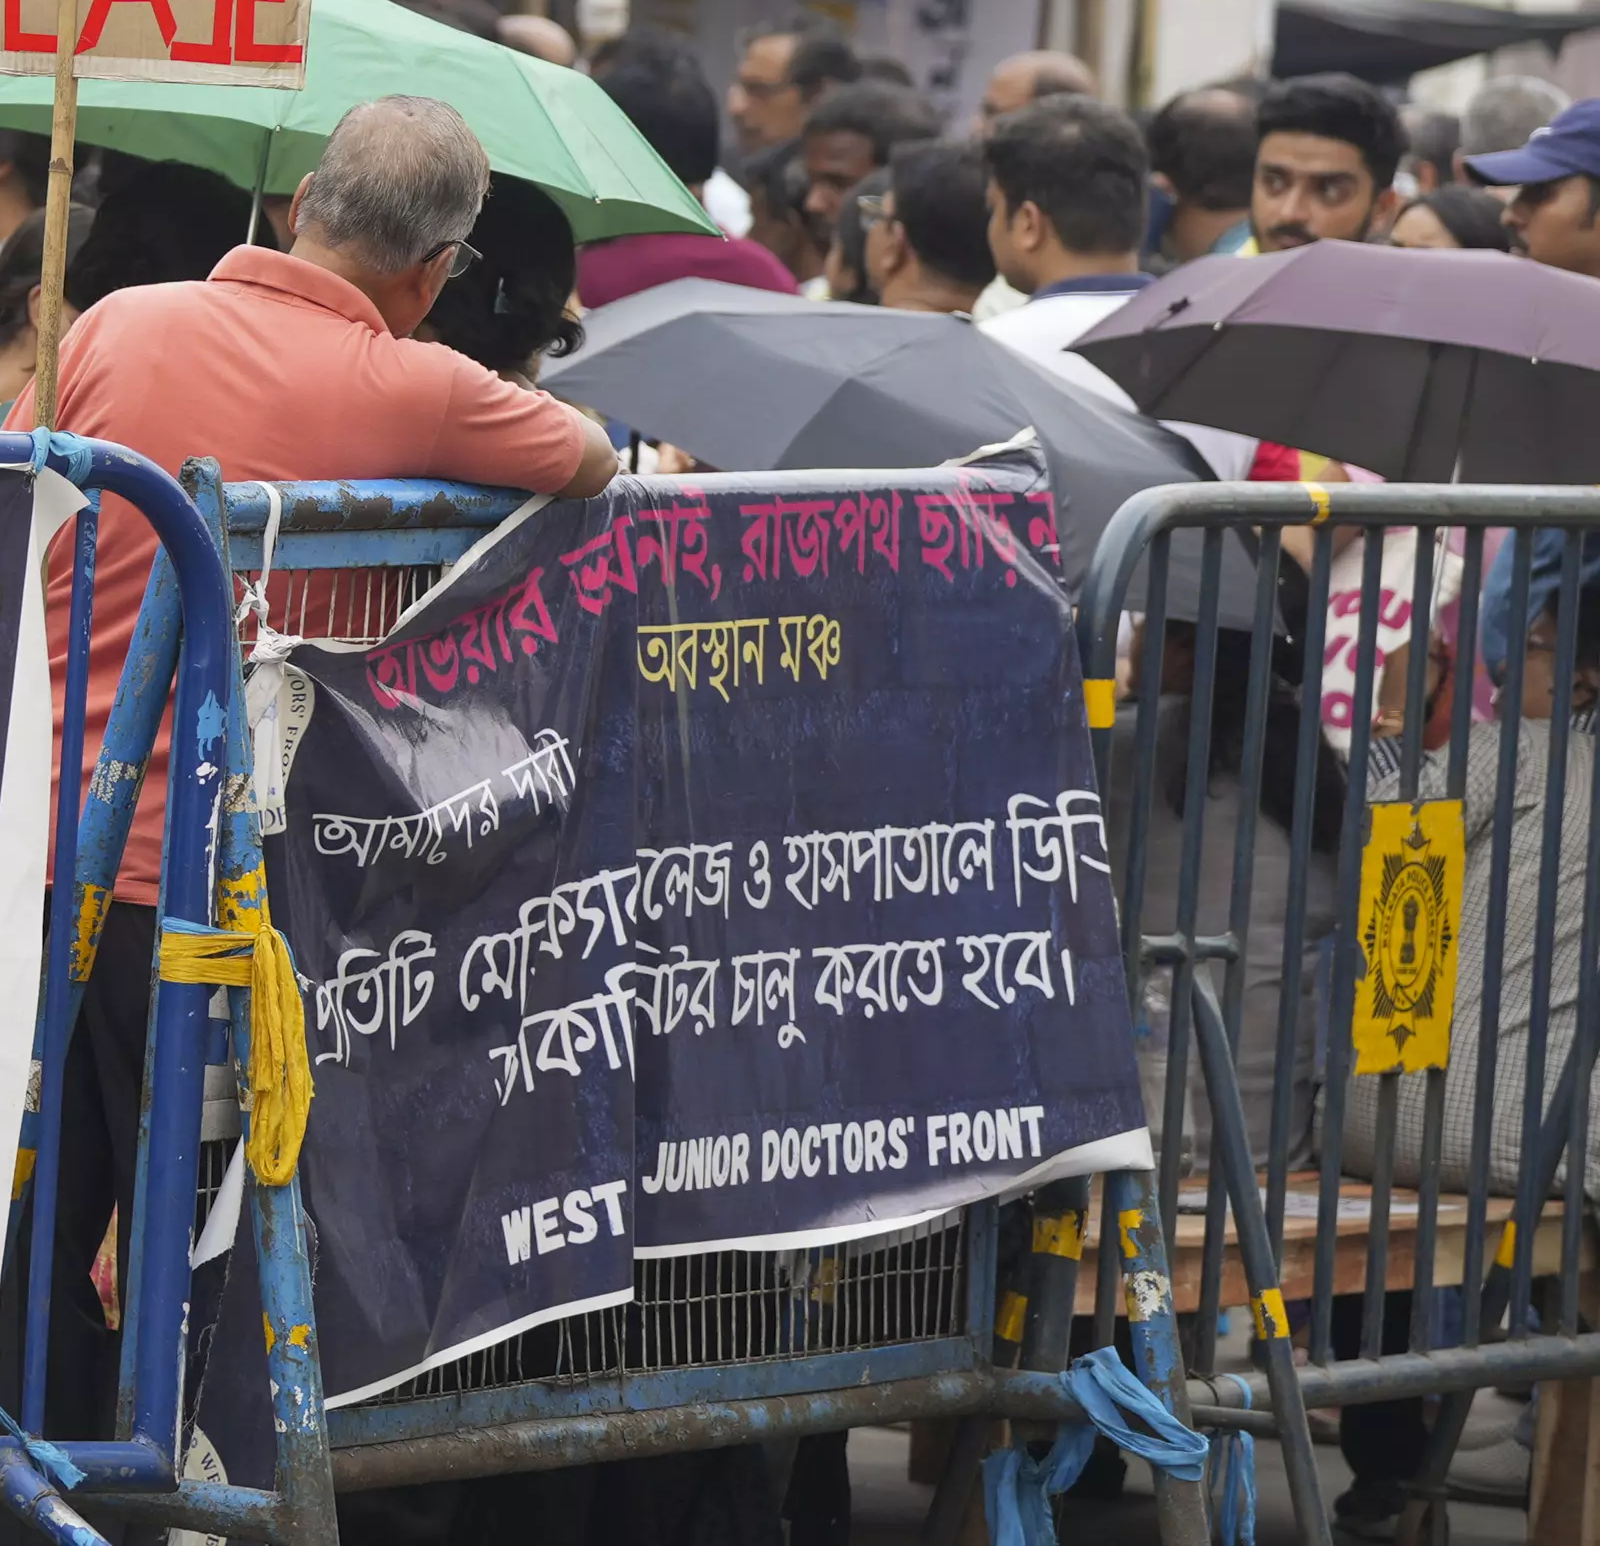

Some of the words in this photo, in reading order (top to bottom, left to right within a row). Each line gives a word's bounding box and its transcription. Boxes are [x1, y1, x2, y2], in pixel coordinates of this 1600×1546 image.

[364, 566, 561, 710] অভয়ার
[738, 488, 904, 585] রাজপথ
[913, 466, 1019, 589] ছাড়ি
[637, 616, 771, 704] অবস্থান
[777, 612, 842, 683] মঞ্চ
[312, 775, 503, 870] আমাদের
[314, 928, 438, 1069] প্রতিটি
[743, 840, 774, 911] ও
[781, 817, 997, 910] হাসপাতালে
[730, 946, 807, 1051] চালু
[811, 937, 947, 1020] করতে
[500, 1178, 629, 1268] WEST
[640, 1132, 752, 1197] JUNIOR
[759, 1115, 911, 1186] DOCTORS'
[925, 1104, 1048, 1169] FRONT
